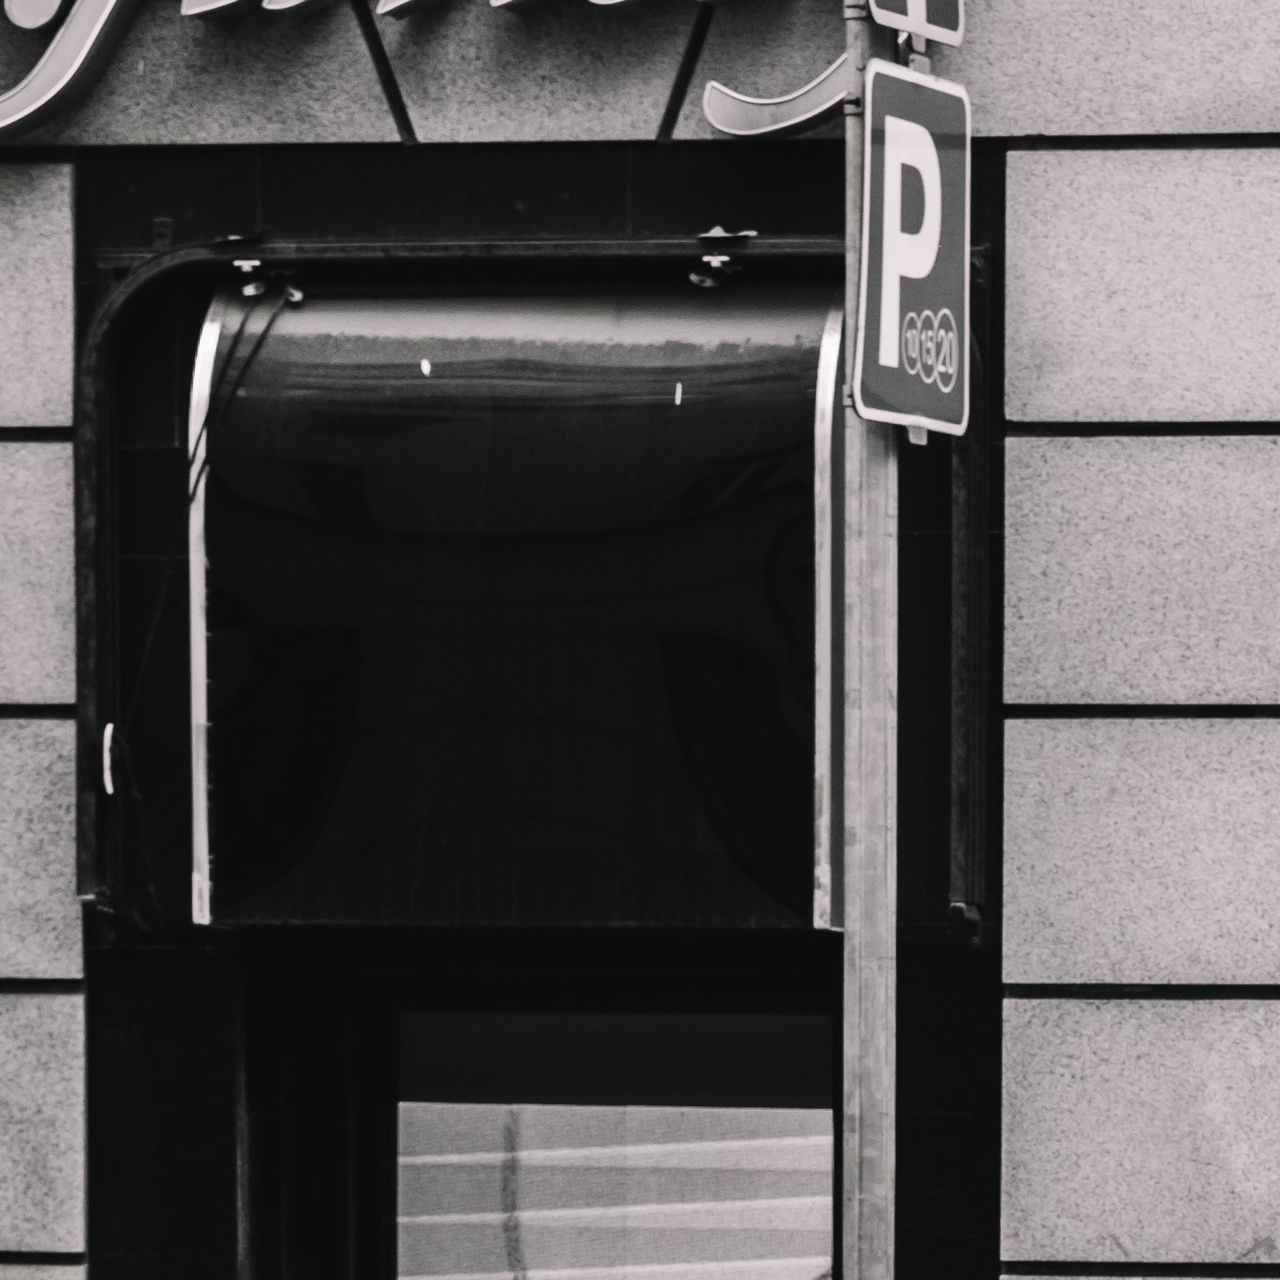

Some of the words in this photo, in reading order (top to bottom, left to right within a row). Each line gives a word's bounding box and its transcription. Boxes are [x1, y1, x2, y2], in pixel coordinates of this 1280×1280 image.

[878, 114, 942, 370] P
[920, 329, 935, 365] 15
[936, 328, 957, 374] 20
